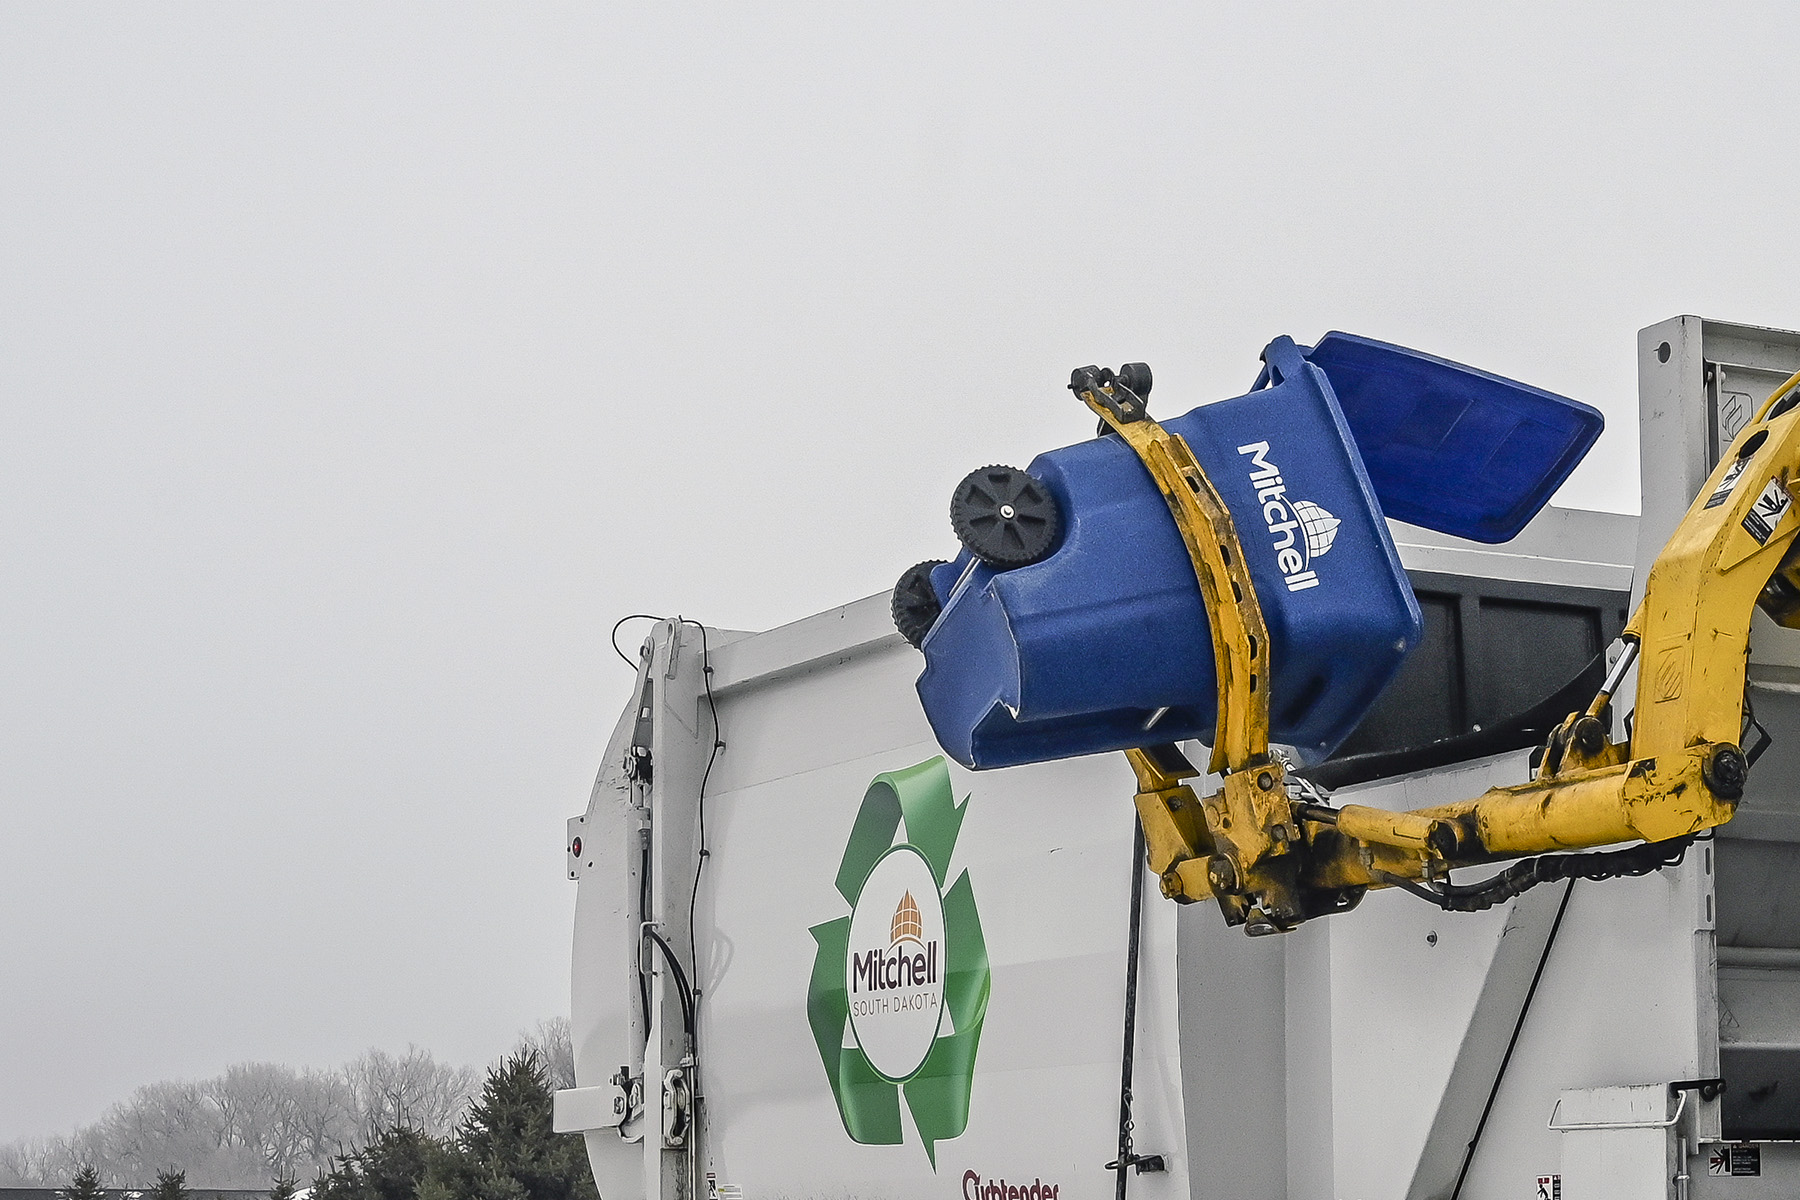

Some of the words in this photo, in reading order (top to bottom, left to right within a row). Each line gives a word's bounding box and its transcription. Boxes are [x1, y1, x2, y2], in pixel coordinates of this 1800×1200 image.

[1237, 440, 1320, 592] Mitchell
[852, 940, 938, 993] Mitchell
[853, 997, 889, 1017] SOUTH
[893, 992, 938, 1013] DAKOTA
